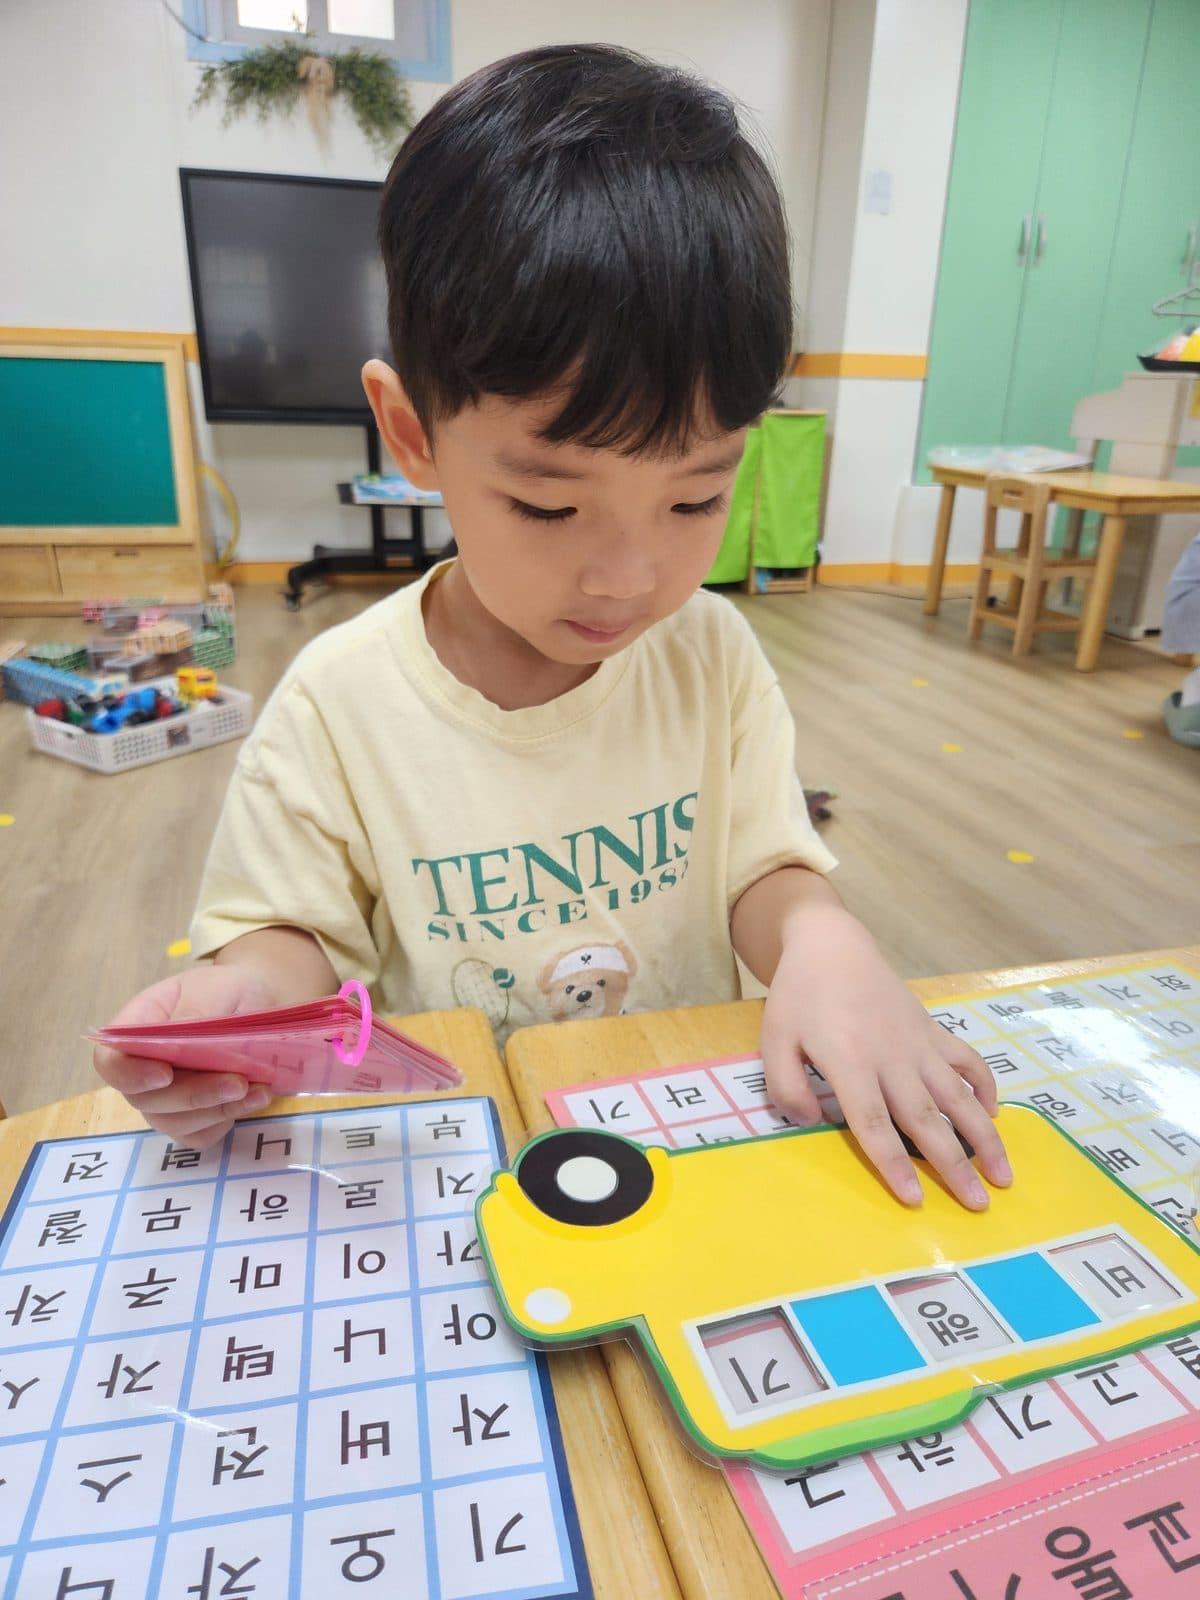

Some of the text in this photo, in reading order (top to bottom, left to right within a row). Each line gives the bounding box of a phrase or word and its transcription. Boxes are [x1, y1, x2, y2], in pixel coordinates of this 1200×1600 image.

[411, 792, 698, 917] TENNIS
[427, 900, 588, 943] SINCE
[588, 1099, 630, 1124] 기
[664, 1084, 706, 1109] 라
[62, 1114, 466, 1184] 부 트 니 럭 전
[1084, 1144, 1141, 1174] 배
[37, 1166, 477, 1248] 지 로 하 무 철
[229, 1255, 282, 1294] 마
[343, 1243, 386, 1280] 이
[4, 1284, 67, 1327] 차
[122, 1267, 177, 1309] 주
[96, 1302, 499, 1399] 야 나 택 자
[728, 1258, 1147, 1404] 비 행 기
[986, 1393, 1053, 1441] 기
[77, 1393, 511, 1503] 자 버 전 스
[330, 1528, 396, 1583] 오
[469, 1502, 527, 1563] 기
